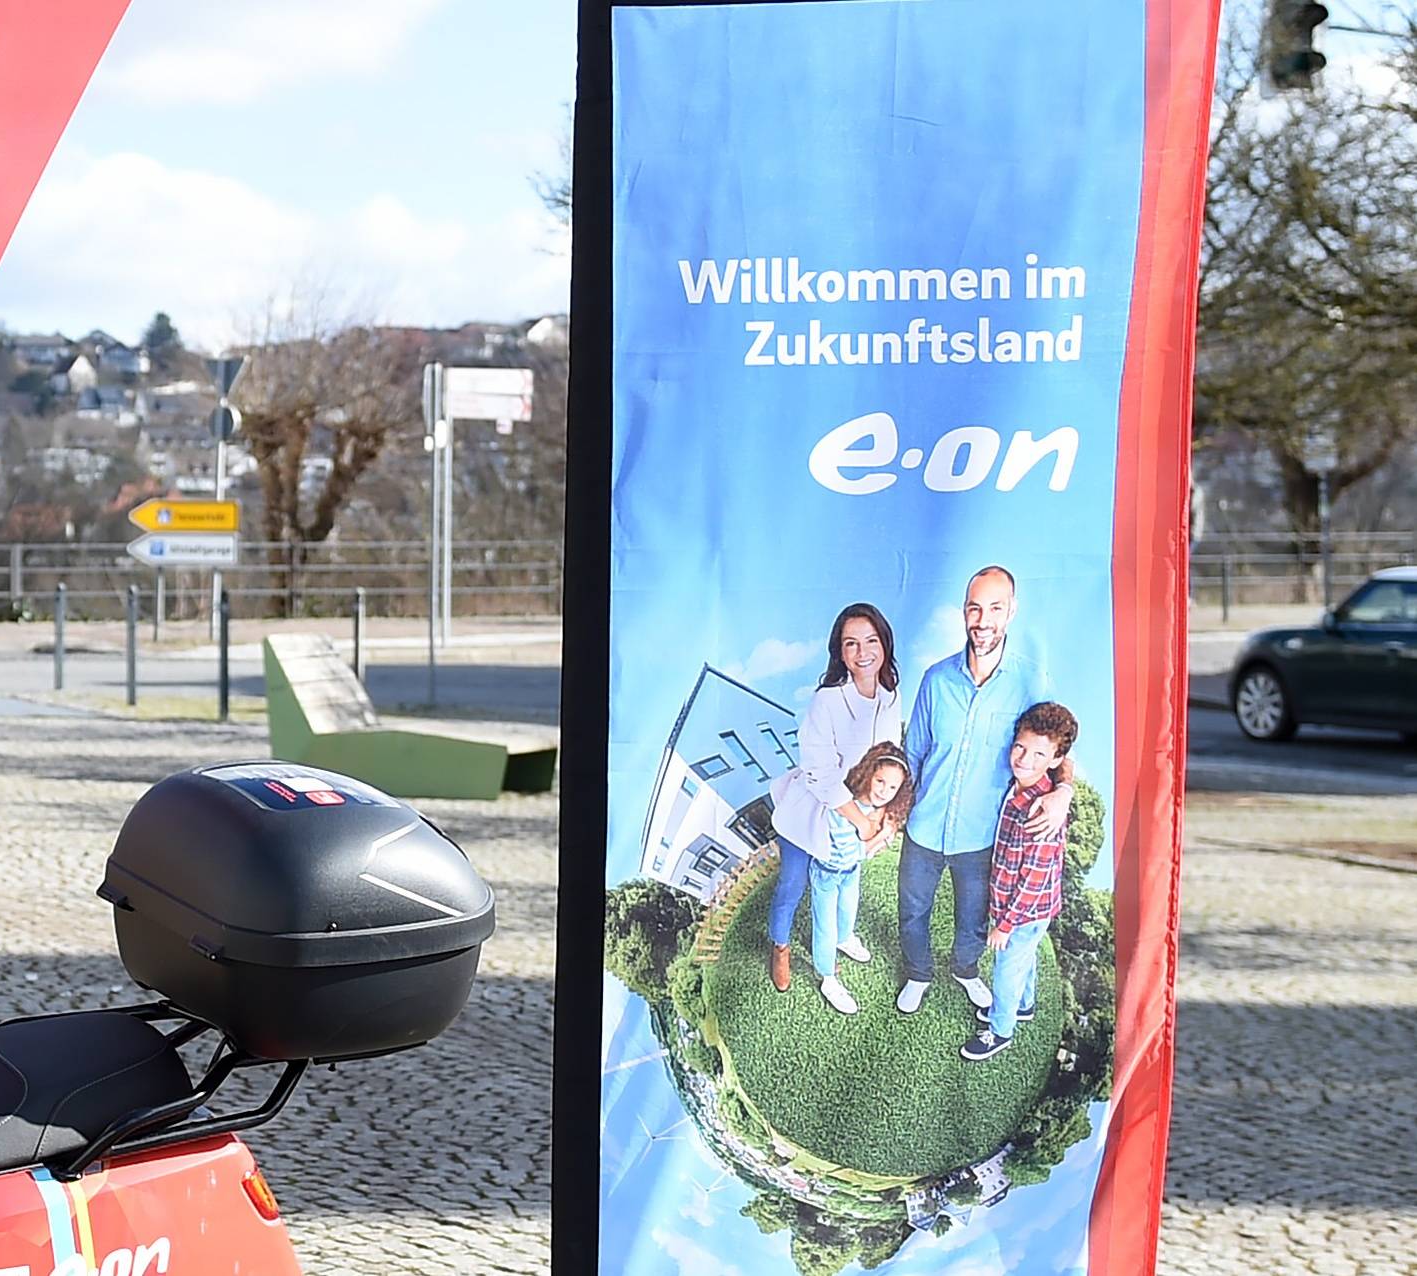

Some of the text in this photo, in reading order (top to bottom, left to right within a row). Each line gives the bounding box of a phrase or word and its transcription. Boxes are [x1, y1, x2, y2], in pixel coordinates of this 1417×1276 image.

[678, 253, 1086, 304] Willkommen im
[744, 315, 1083, 366] Zukunftsland
